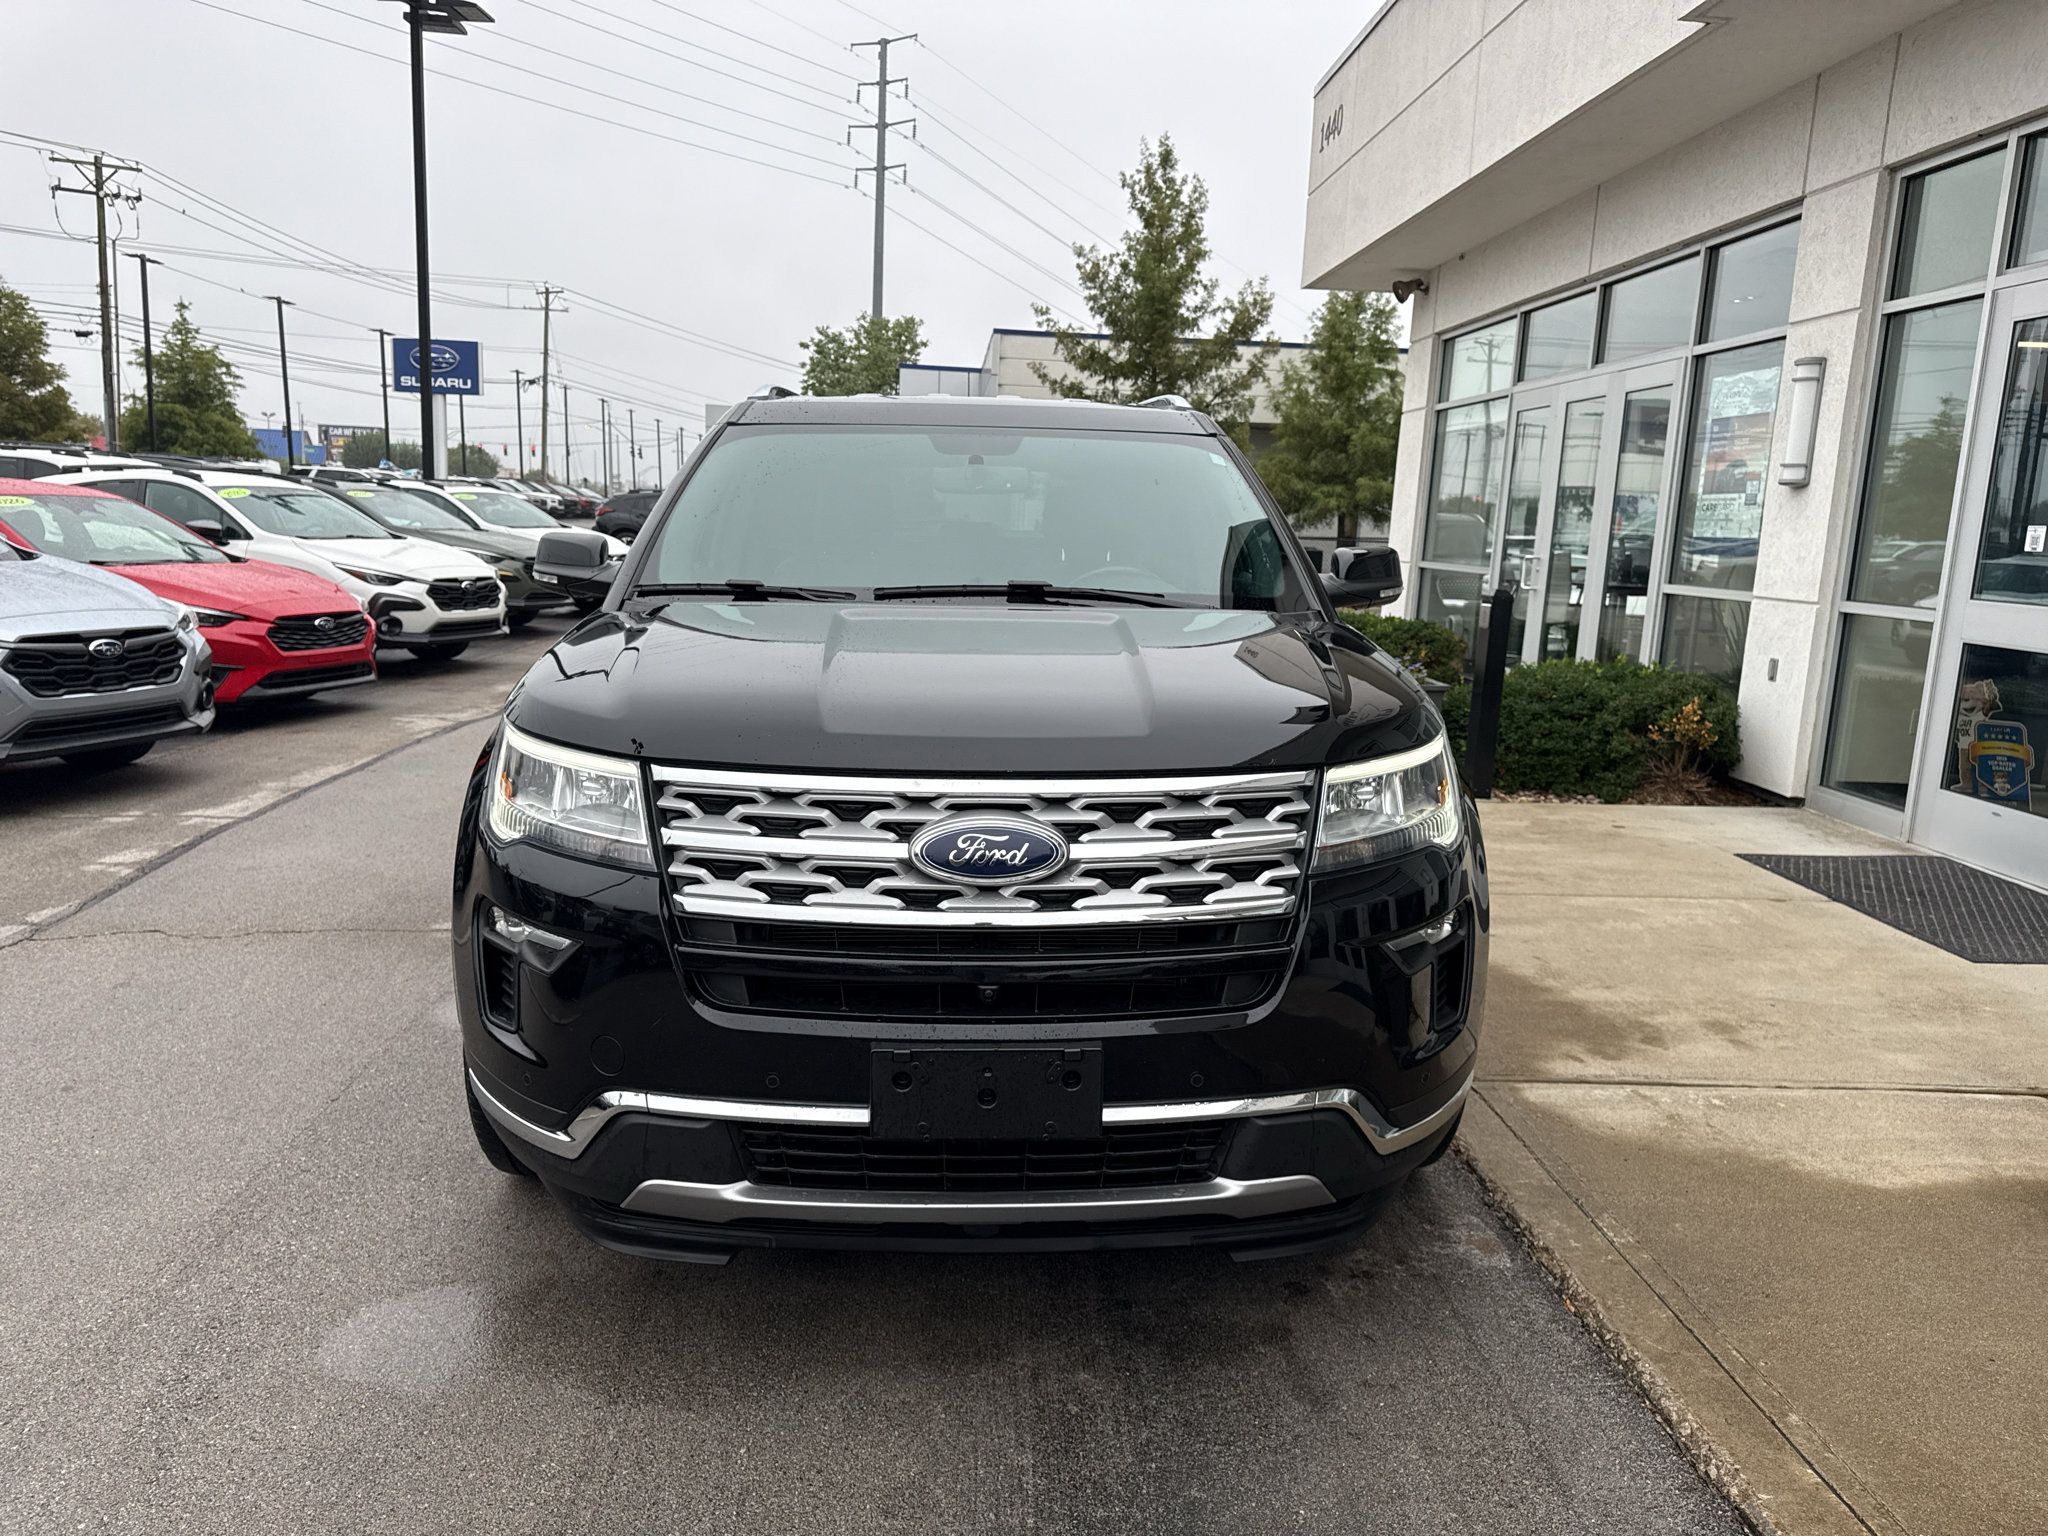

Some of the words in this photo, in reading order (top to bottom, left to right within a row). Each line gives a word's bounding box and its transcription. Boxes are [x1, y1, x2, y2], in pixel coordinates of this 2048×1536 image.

[1319, 104, 1344, 153] 1440
[400, 375, 472, 389] SUARU
[949, 833, 1030, 865] Ford
